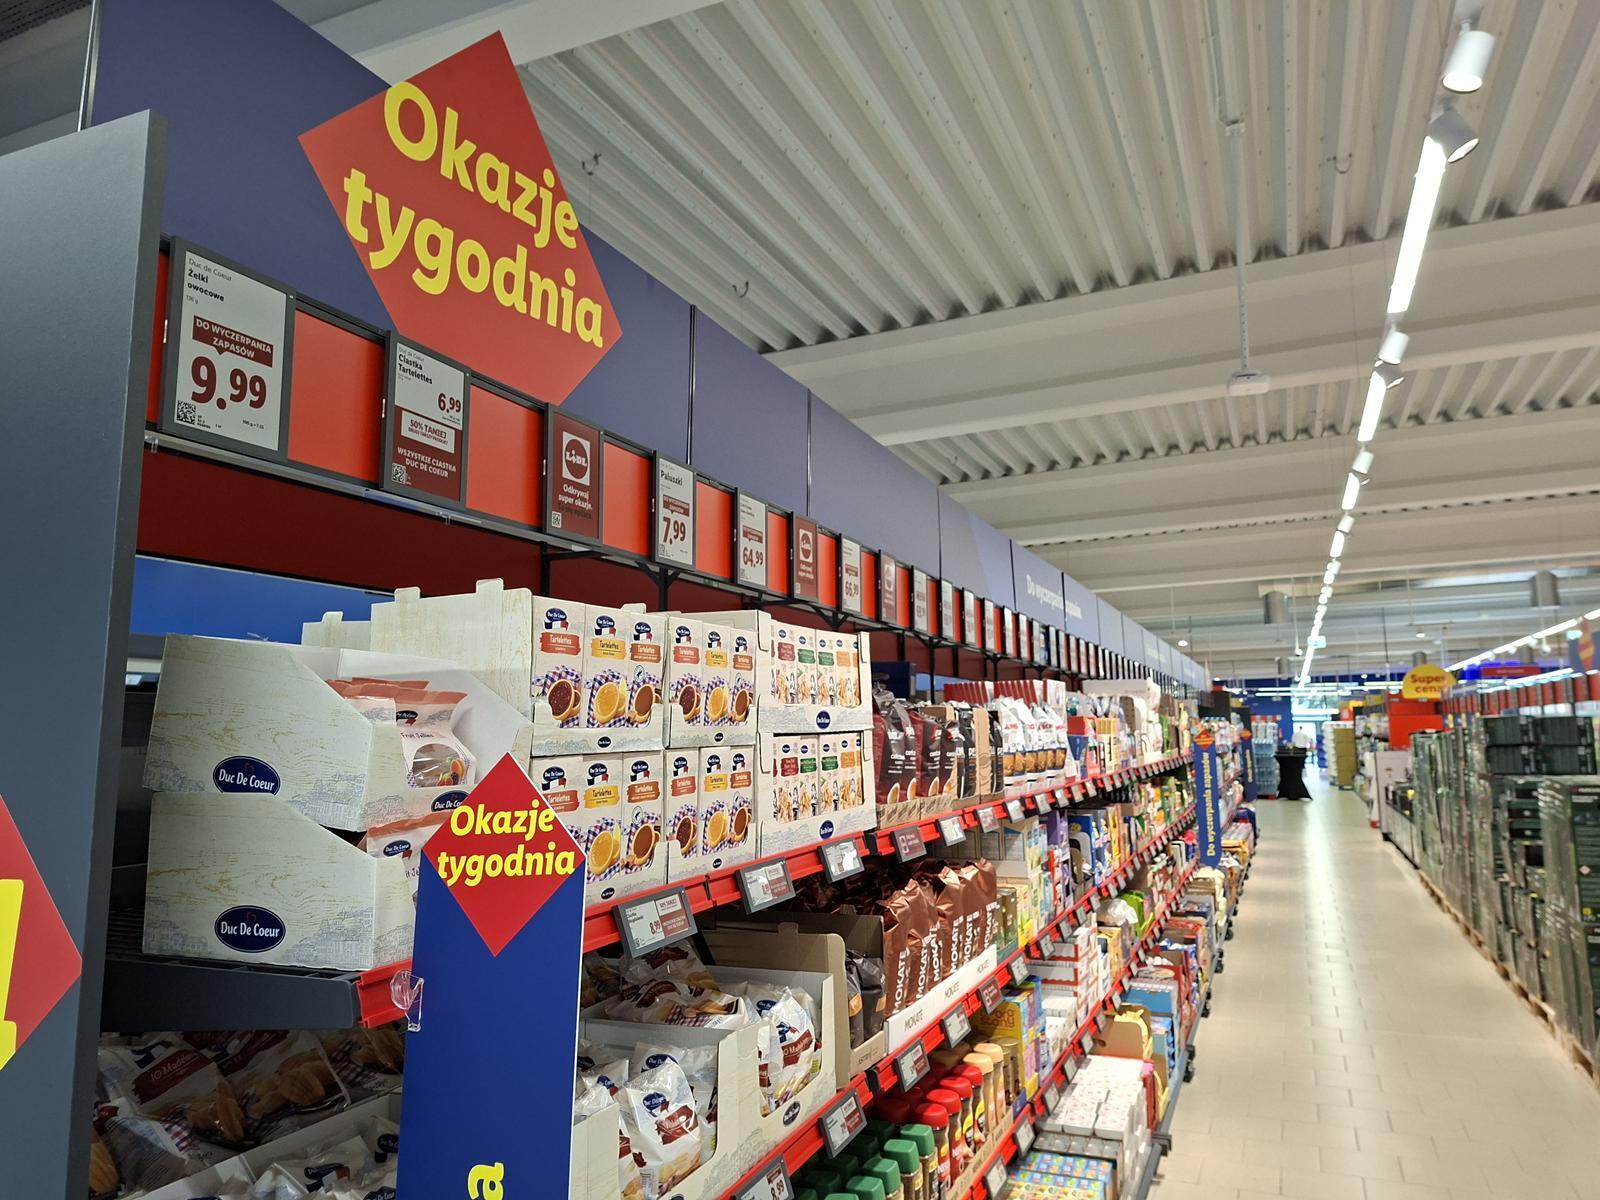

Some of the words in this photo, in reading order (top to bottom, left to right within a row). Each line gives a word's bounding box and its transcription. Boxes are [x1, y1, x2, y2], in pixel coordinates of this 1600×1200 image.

[383, 81, 579, 249] Okazje
[188, 257, 201, 267] Duc
[343, 167, 604, 348] tygodnia
[187, 268, 209, 283] Żelki
[187, 282, 225, 302] owocowe
[196, 318, 210, 330] DO
[211, 324, 272, 354] WYCZERPANIA
[213, 336, 255, 358] ZAPASÓW
[398, 353, 423, 370] Ciastka
[191, 355, 267, 411] 9.99
[398, 363, 433, 384] Tartelettes
[410, 419, 423, 430] 50%
[424, 424, 447, 439] TANIEJ
[397, 447, 431, 463] WSZYSTKIE
[431, 458, 456, 472] CIASTKA
[405, 458, 419, 469] DUC
[420, 463, 428, 472] DE
[428, 465, 449, 478] COEUR
[1410, 673, 1445, 685] Super
[219, 768, 235, 783] Duc
[236, 772, 248, 786] De
[249, 775, 276, 791] Coeur
[434, 801, 445, 809] Duc
[445, 800, 453, 808] De
[1203, 789, 1216, 842] wyczerpania
[450, 799, 556, 841] Okazje
[1207, 843, 1216, 857] Do
[437, 841, 576, 887] tygodnia
[221, 921, 237, 935] Duc
[240, 922, 252, 936] De
[253, 923, 280, 937] Coeur
[950, 918, 960, 973] MOKATE
[892, 950, 907, 1014] MOKATE
